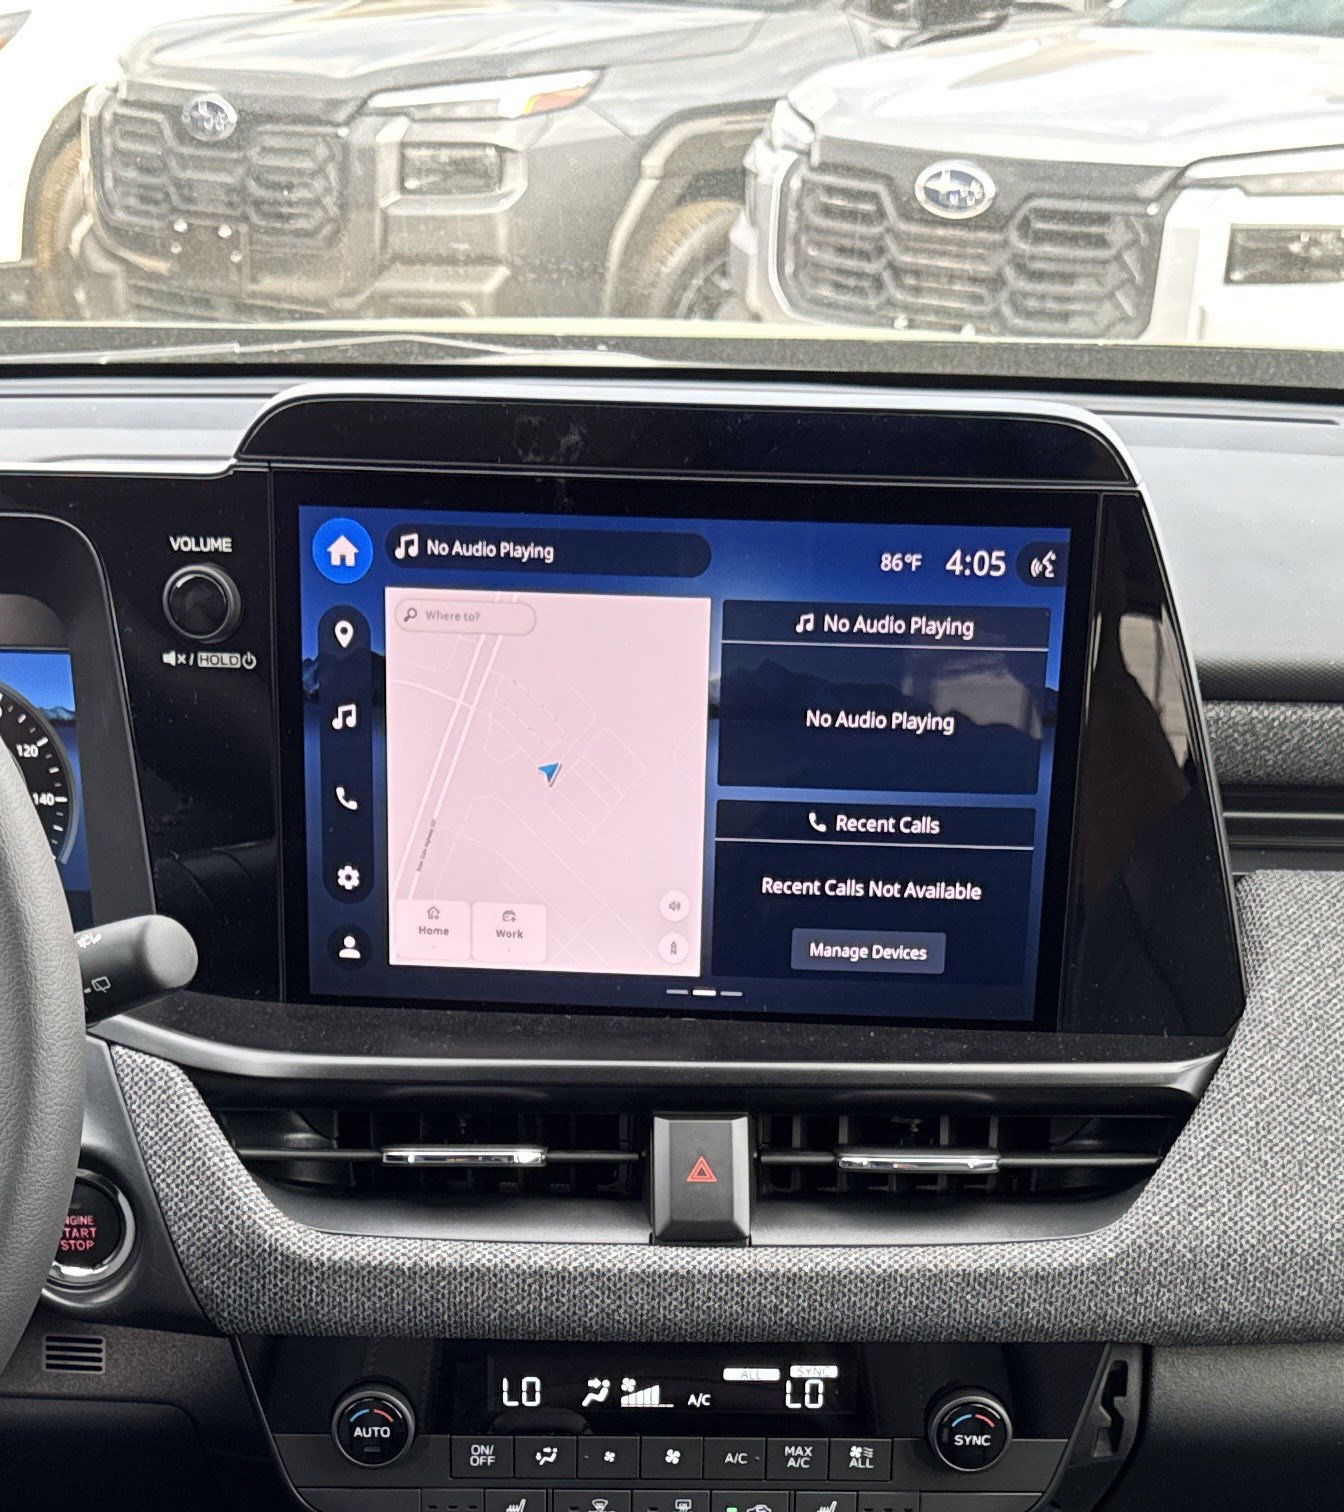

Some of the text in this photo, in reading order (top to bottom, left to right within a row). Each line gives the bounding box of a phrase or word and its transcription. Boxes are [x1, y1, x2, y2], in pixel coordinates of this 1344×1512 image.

[169, 536, 233, 553] VOLUME
[427, 539, 555, 563] No Audio Playing
[945, 549, 1006, 577] 4:05
[425, 610, 481, 622] Where to?
[824, 615, 975, 640] No Audio Playing
[200, 654, 239, 666] HOLD
[806, 709, 955, 735] No Audio Playing
[16, 744, 39, 757] 120
[32, 792, 55, 806] 140
[836, 814, 940, 835] Recent Calls
[761, 877, 982, 901] Recent Calls Not Available
[418, 926, 450, 936] Home
[495, 929, 524, 939] Work
[809, 942, 928, 962] Manage Devices
[65, 1215, 94, 1226] NGINE
[64, 1228, 97, 1239] TART
[60, 1240, 95, 1251] STOP
[687, 1393, 711, 1407] A/C
[353, 1426, 391, 1438] AUTO
[954, 1434, 991, 1447] SYNC
[470, 1445, 494, 1456] ON/
[785, 1445, 813, 1458] MAX
[469, 1456, 495, 1467] OFF
[725, 1452, 748, 1465] A/C
[787, 1457, 810, 1469] A/C
[849, 1458, 874, 1469] ALL
